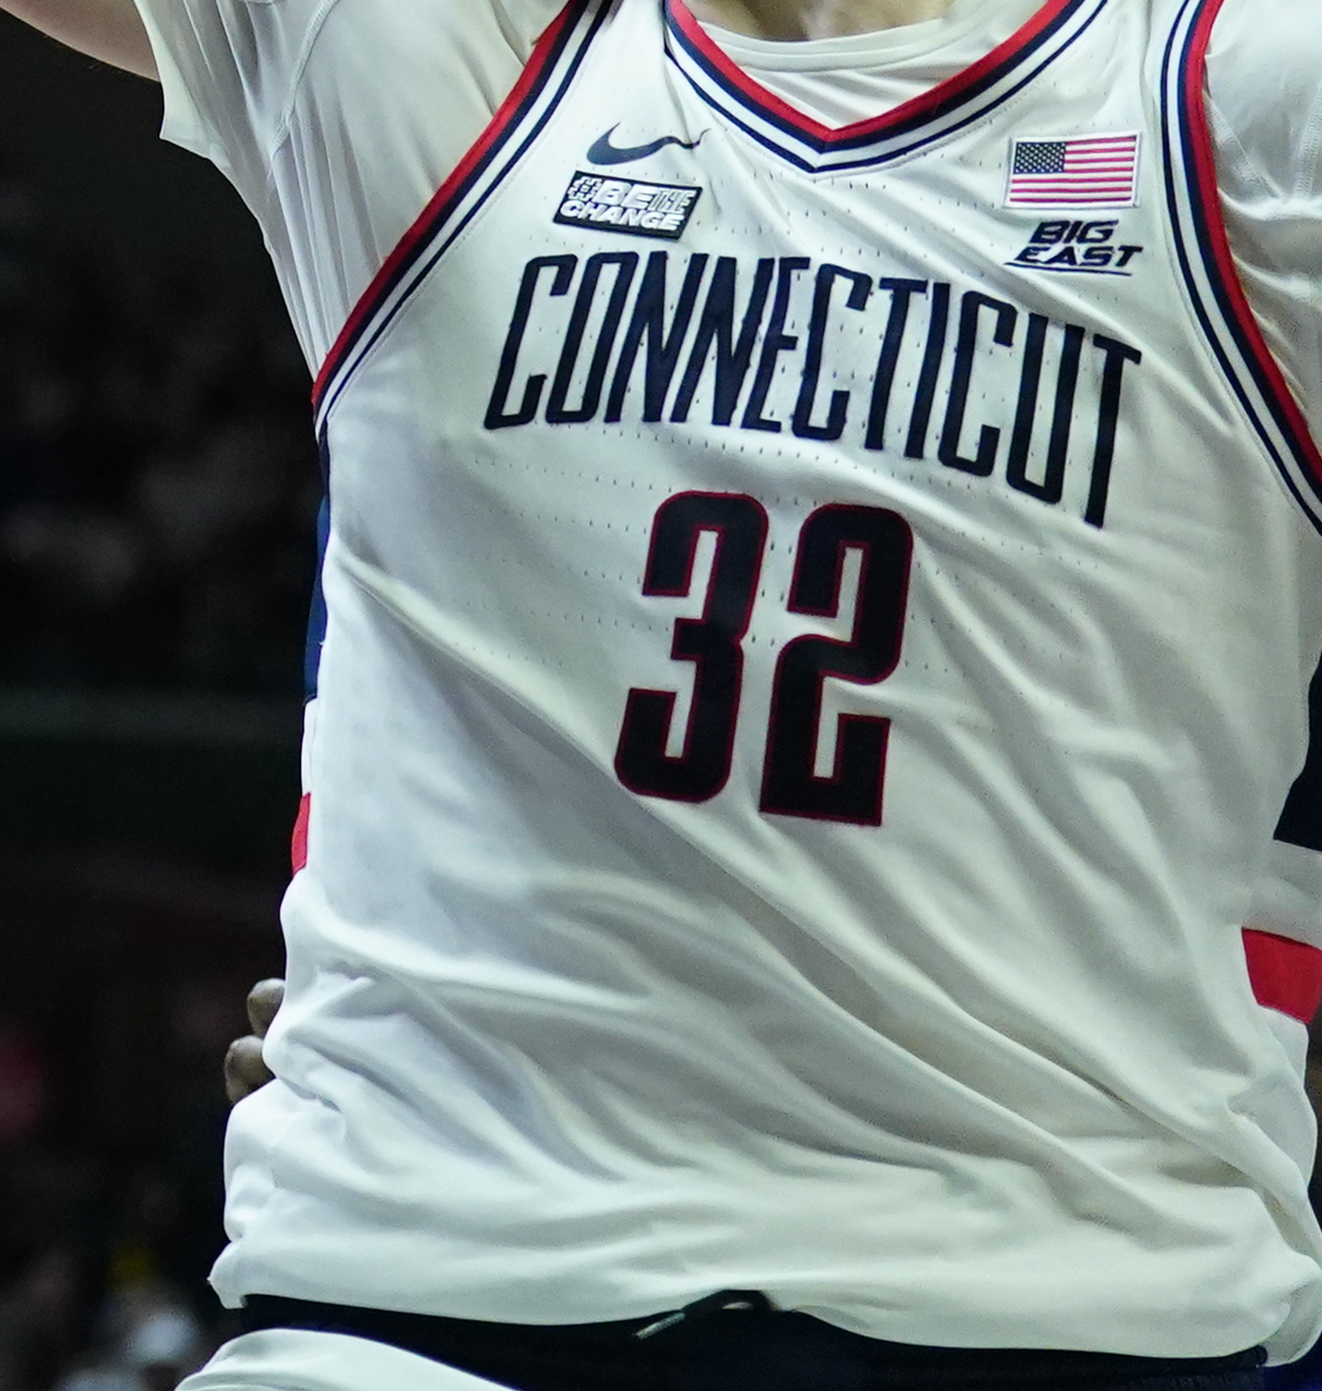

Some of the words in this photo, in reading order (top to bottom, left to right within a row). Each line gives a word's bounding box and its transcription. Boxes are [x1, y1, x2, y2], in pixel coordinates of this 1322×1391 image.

[560, 200, 685, 231] CHANGE
[1029, 220, 1119, 244] BIG
[1014, 245, 1143, 268] EAST
[484, 250, 1142, 528] CONNECTICUT
[614, 491, 914, 826] 32
